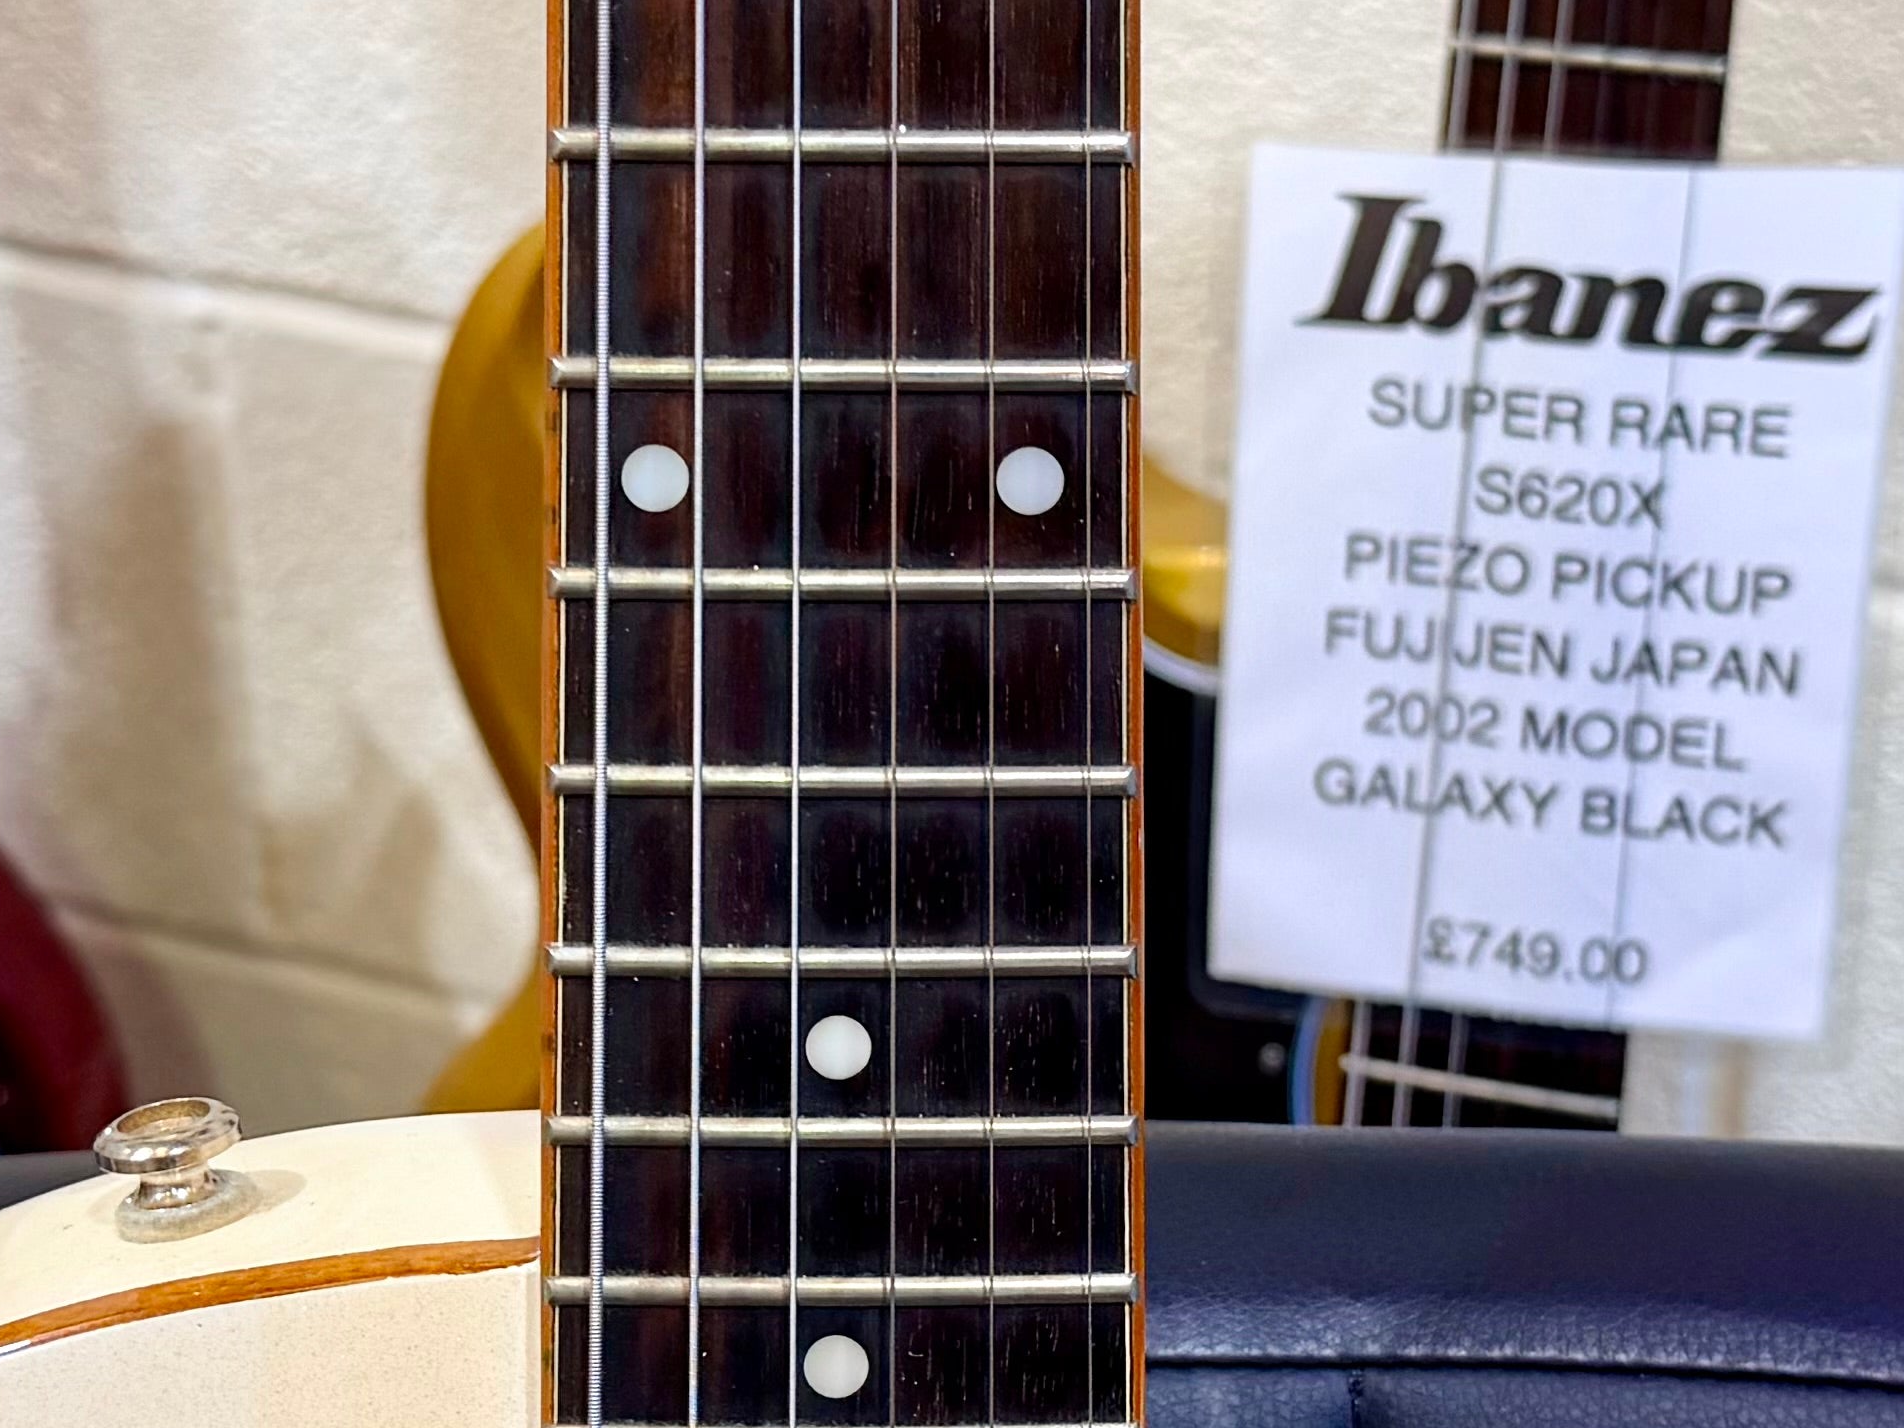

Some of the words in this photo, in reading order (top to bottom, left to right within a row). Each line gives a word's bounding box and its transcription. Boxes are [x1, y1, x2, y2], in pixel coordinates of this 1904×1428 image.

[1296, 190, 1882, 362] Ibanez
[1368, 380, 1587, 445] SUPER
[1608, 398, 1793, 458] RARE
[1474, 466, 1667, 531] S620X
[1344, 532, 1530, 598] PIEZO
[1551, 551, 1794, 617] PICKUP
[1590, 638, 1801, 698] JAPAN
[1363, 688, 1504, 748] 2002
[1518, 704, 1748, 772] MODEL
[1313, 758, 1560, 830] GALAXY
[1579, 778, 1791, 849] BLACK
[1423, 919, 1650, 986] £749.00
